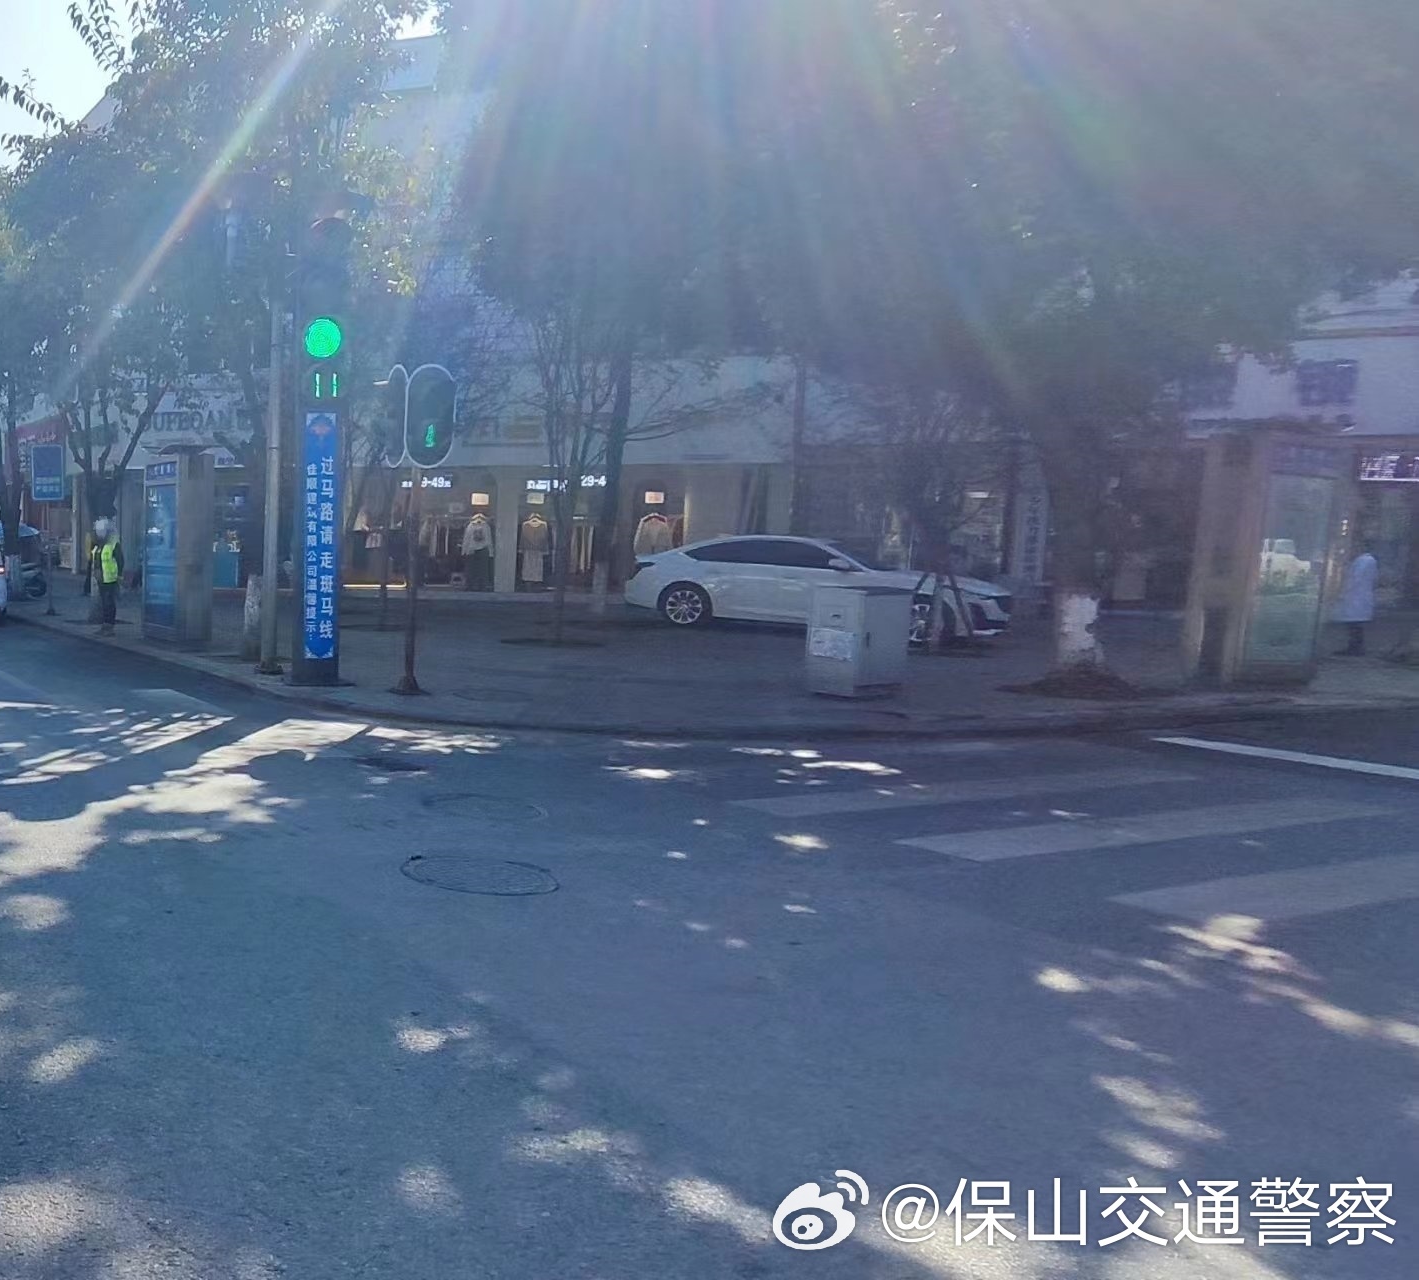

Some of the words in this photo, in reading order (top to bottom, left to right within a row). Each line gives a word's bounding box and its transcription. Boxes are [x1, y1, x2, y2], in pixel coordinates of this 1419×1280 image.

[315, 373, 337, 398] 11
[320, 456, 333, 639] 过马路请走斑马线
